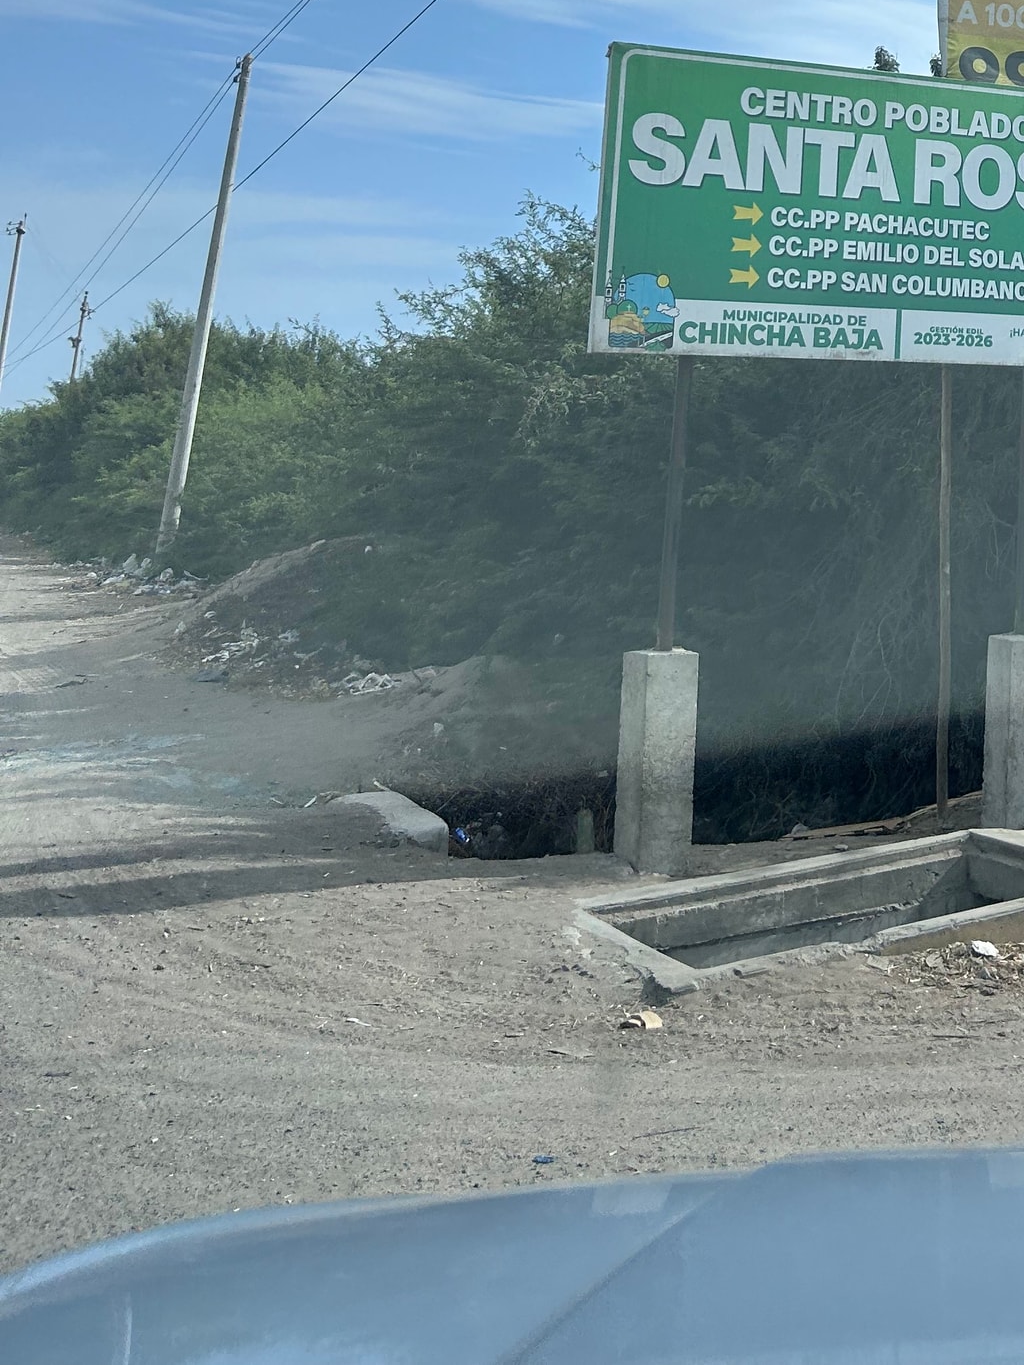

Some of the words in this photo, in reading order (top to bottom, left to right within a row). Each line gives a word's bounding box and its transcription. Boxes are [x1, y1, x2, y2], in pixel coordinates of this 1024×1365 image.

[957, 0, 978, 25] A
[740, 86, 878, 128] CENTRO
[628, 112, 901, 203] SANTA
[770, 206, 840, 231] CC.PP
[844, 212, 990, 241] PACHACUTEC
[768, 235, 839, 259] CC.PP
[843, 240, 919, 264] EMILIO
[924, 246, 965, 267] DEL
[767, 267, 837, 291] CC.PP
[841, 271, 887, 293] SAN
[723, 309, 843, 326] MUNICIPALIDAD
[847, 315, 867, 327] DE
[930, 325, 964, 334] GESTIÓN
[966, 327, 984, 335] EDIL
[678, 321, 806, 347] CHINCHA
[813, 327, 883, 350] BAJA
[914, 331, 993, 348] 2023-2026
